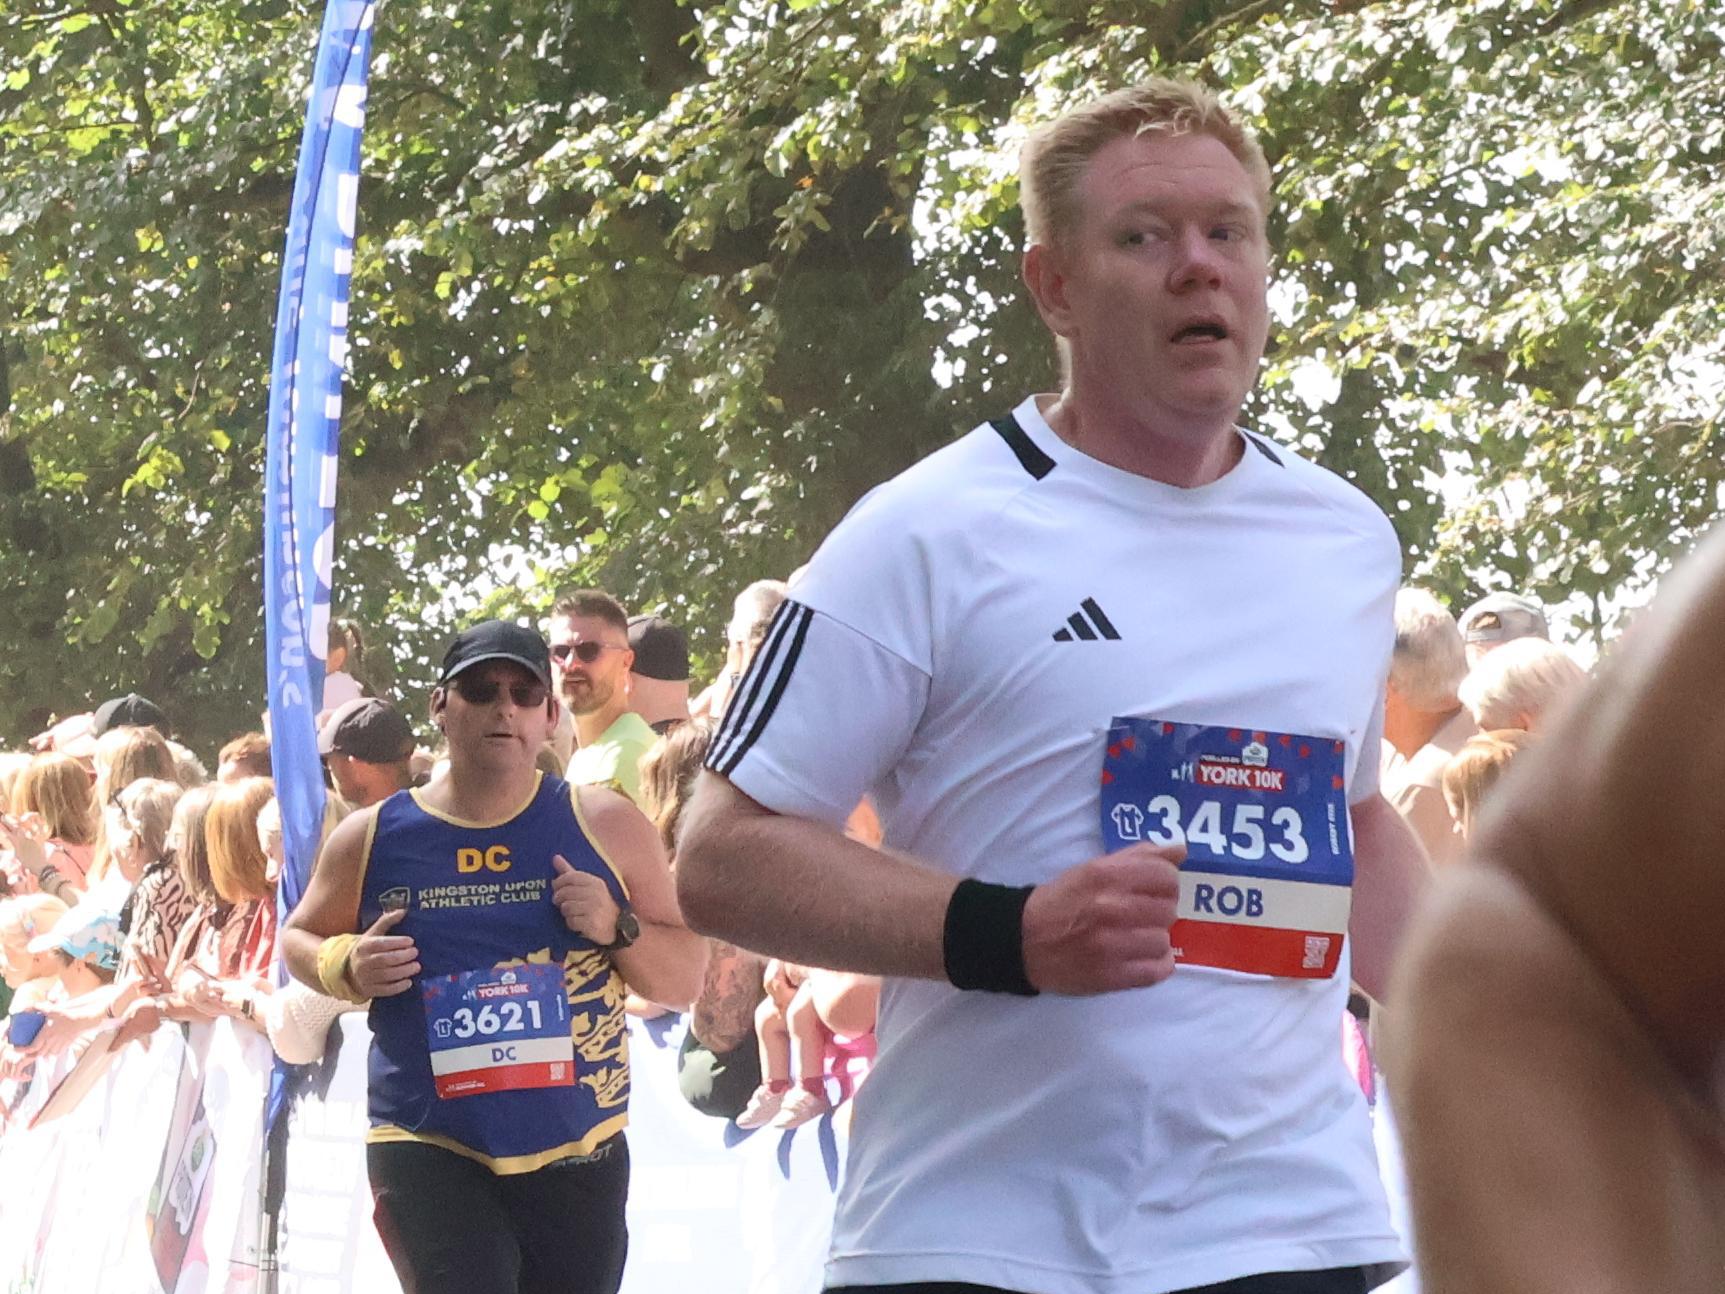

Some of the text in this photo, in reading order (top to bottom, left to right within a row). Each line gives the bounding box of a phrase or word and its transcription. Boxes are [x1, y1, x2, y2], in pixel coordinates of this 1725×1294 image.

[1200, 764, 1283, 790] YORK 10K
[1147, 794, 1309, 864] 3453
[456, 845, 512, 874] DC
[418, 879, 547, 900] KINGSTON UPON
[420, 890, 541, 911] ATHLETIC CLUB
[1194, 883, 1264, 918] ROB
[479, 985, 508, 998] YORK
[510, 983, 529, 995] 10K
[453, 1000, 543, 1038] 3621
[491, 1046, 517, 1063] DC
